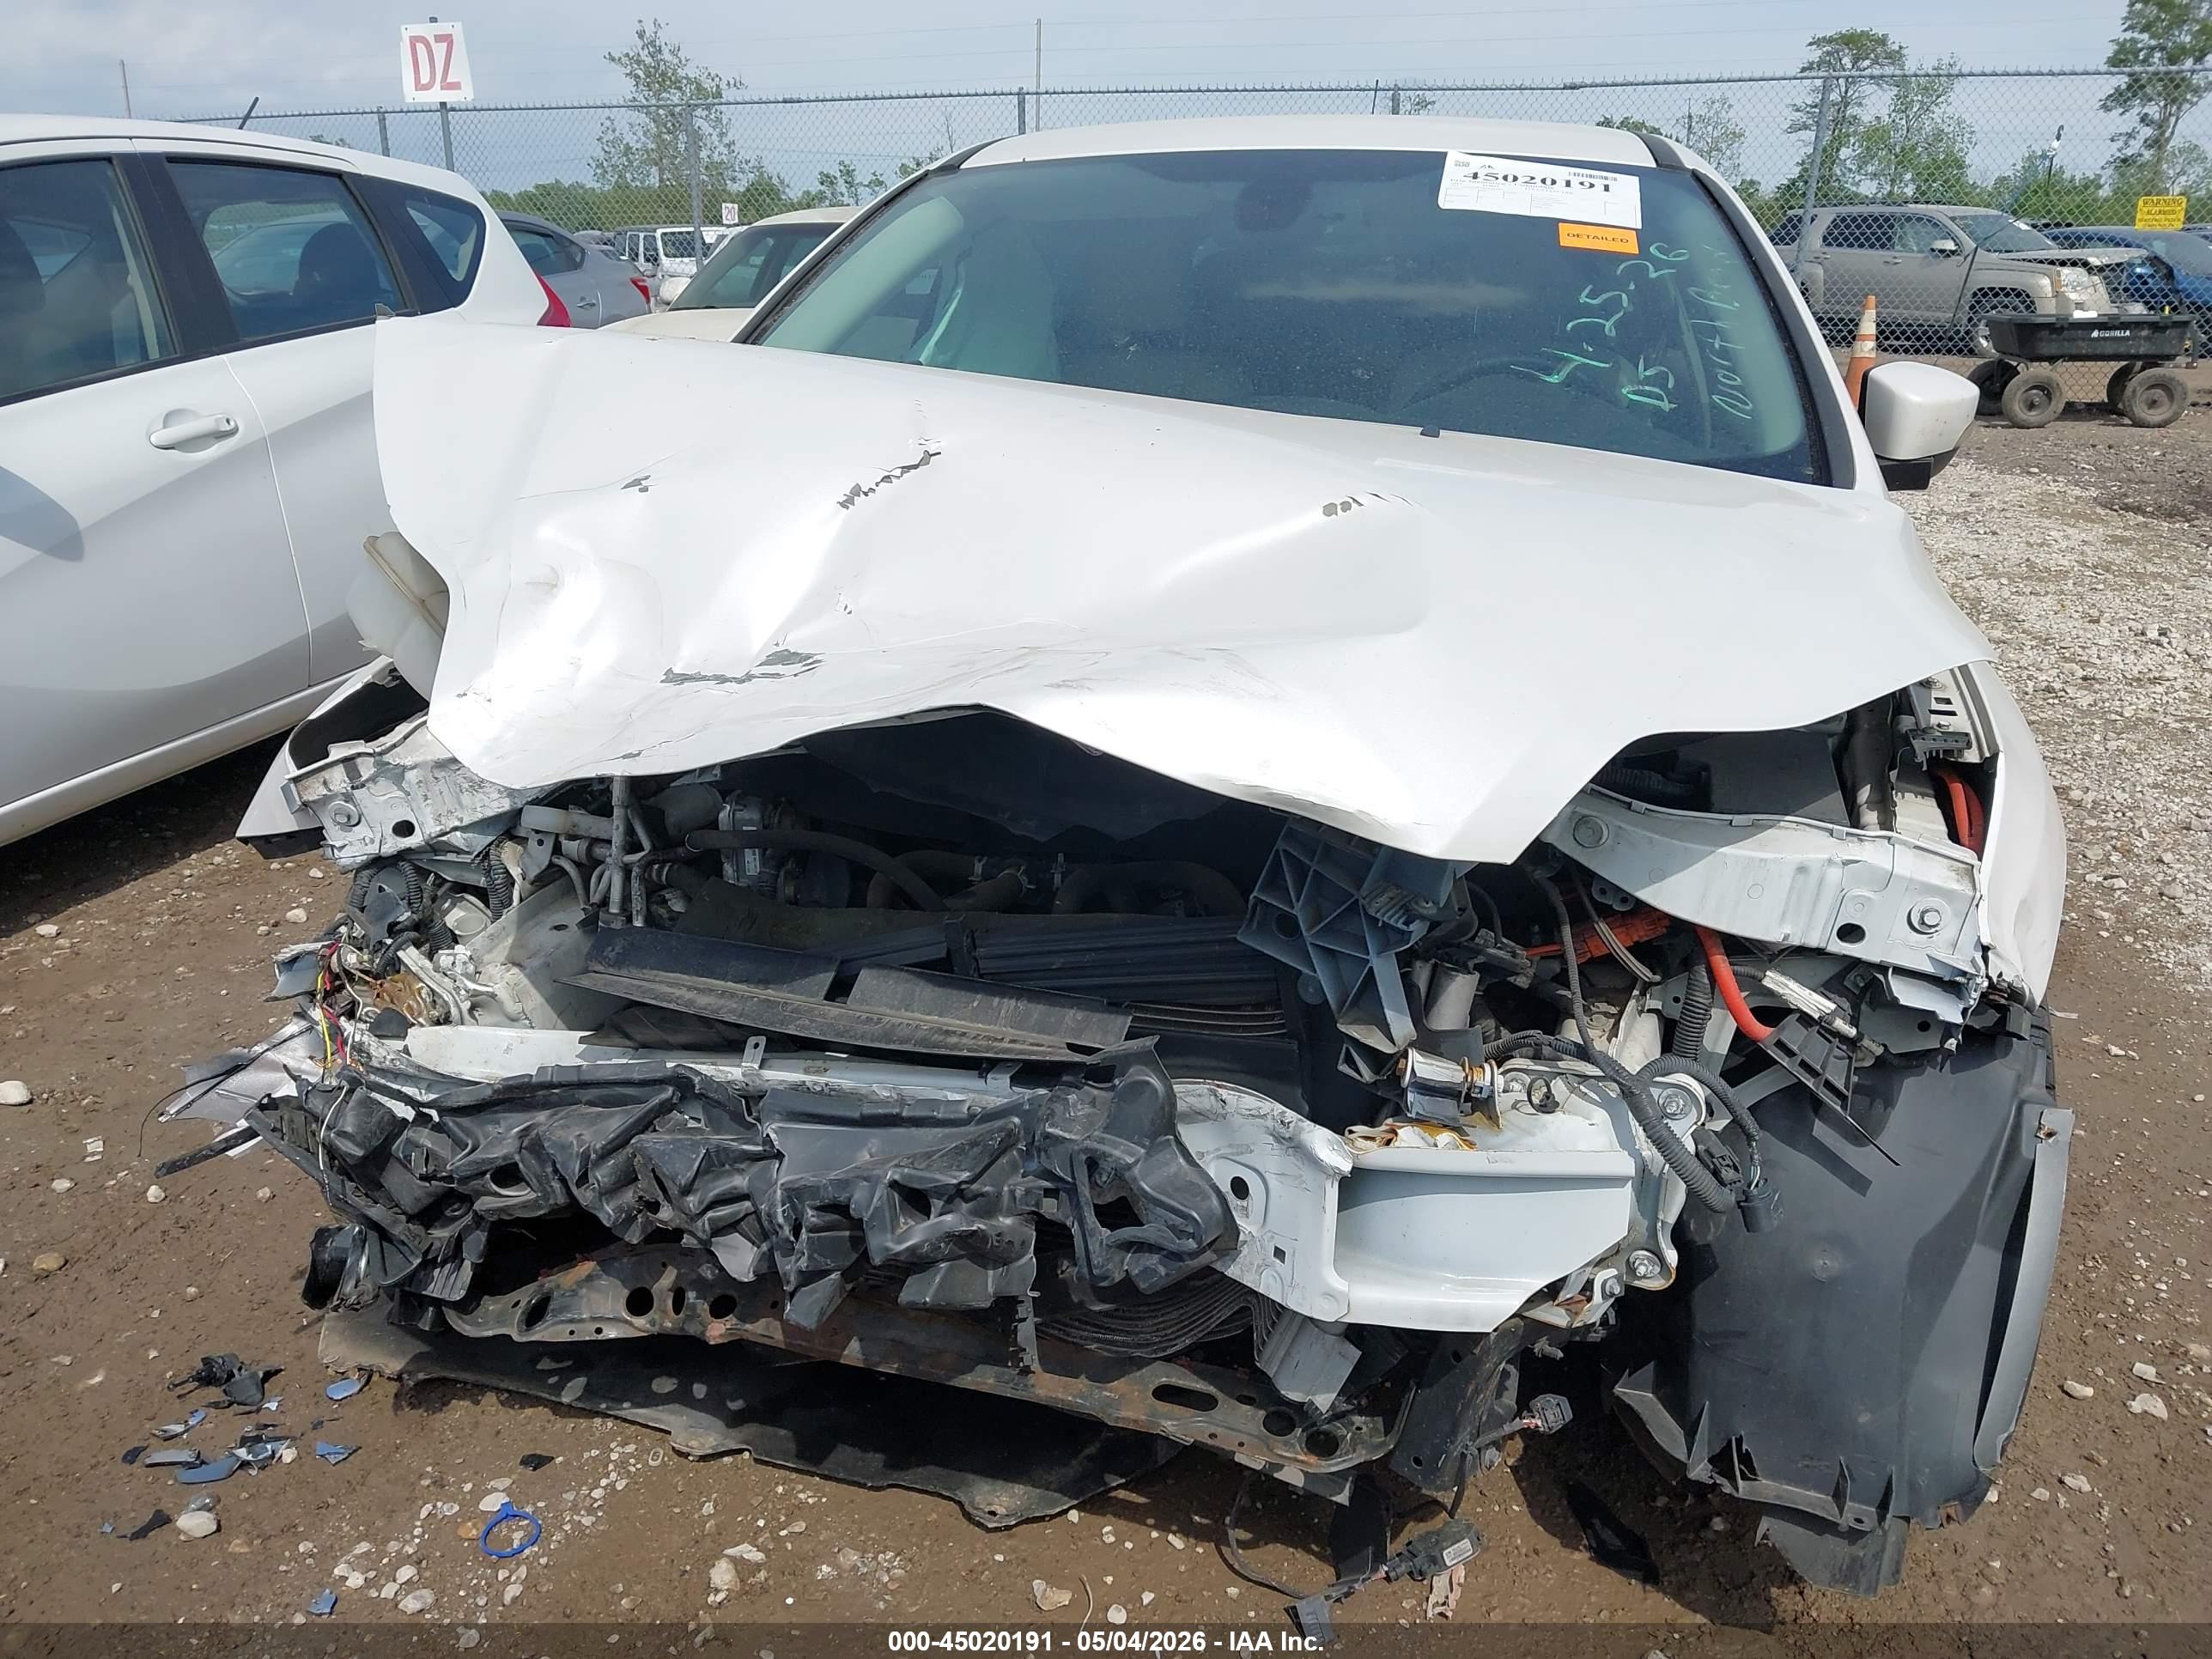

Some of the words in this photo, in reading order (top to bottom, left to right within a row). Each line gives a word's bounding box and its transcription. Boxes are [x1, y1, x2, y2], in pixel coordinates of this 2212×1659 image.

[409, 33, 462, 92] DZ
[1462, 172, 1611, 193] 45020191
[2142, 198, 2185, 207] WARNING
[724, 206, 736, 222] 20
[1566, 231, 1630, 244] DETAILED
[2100, 329, 2130, 337] GORILLA
